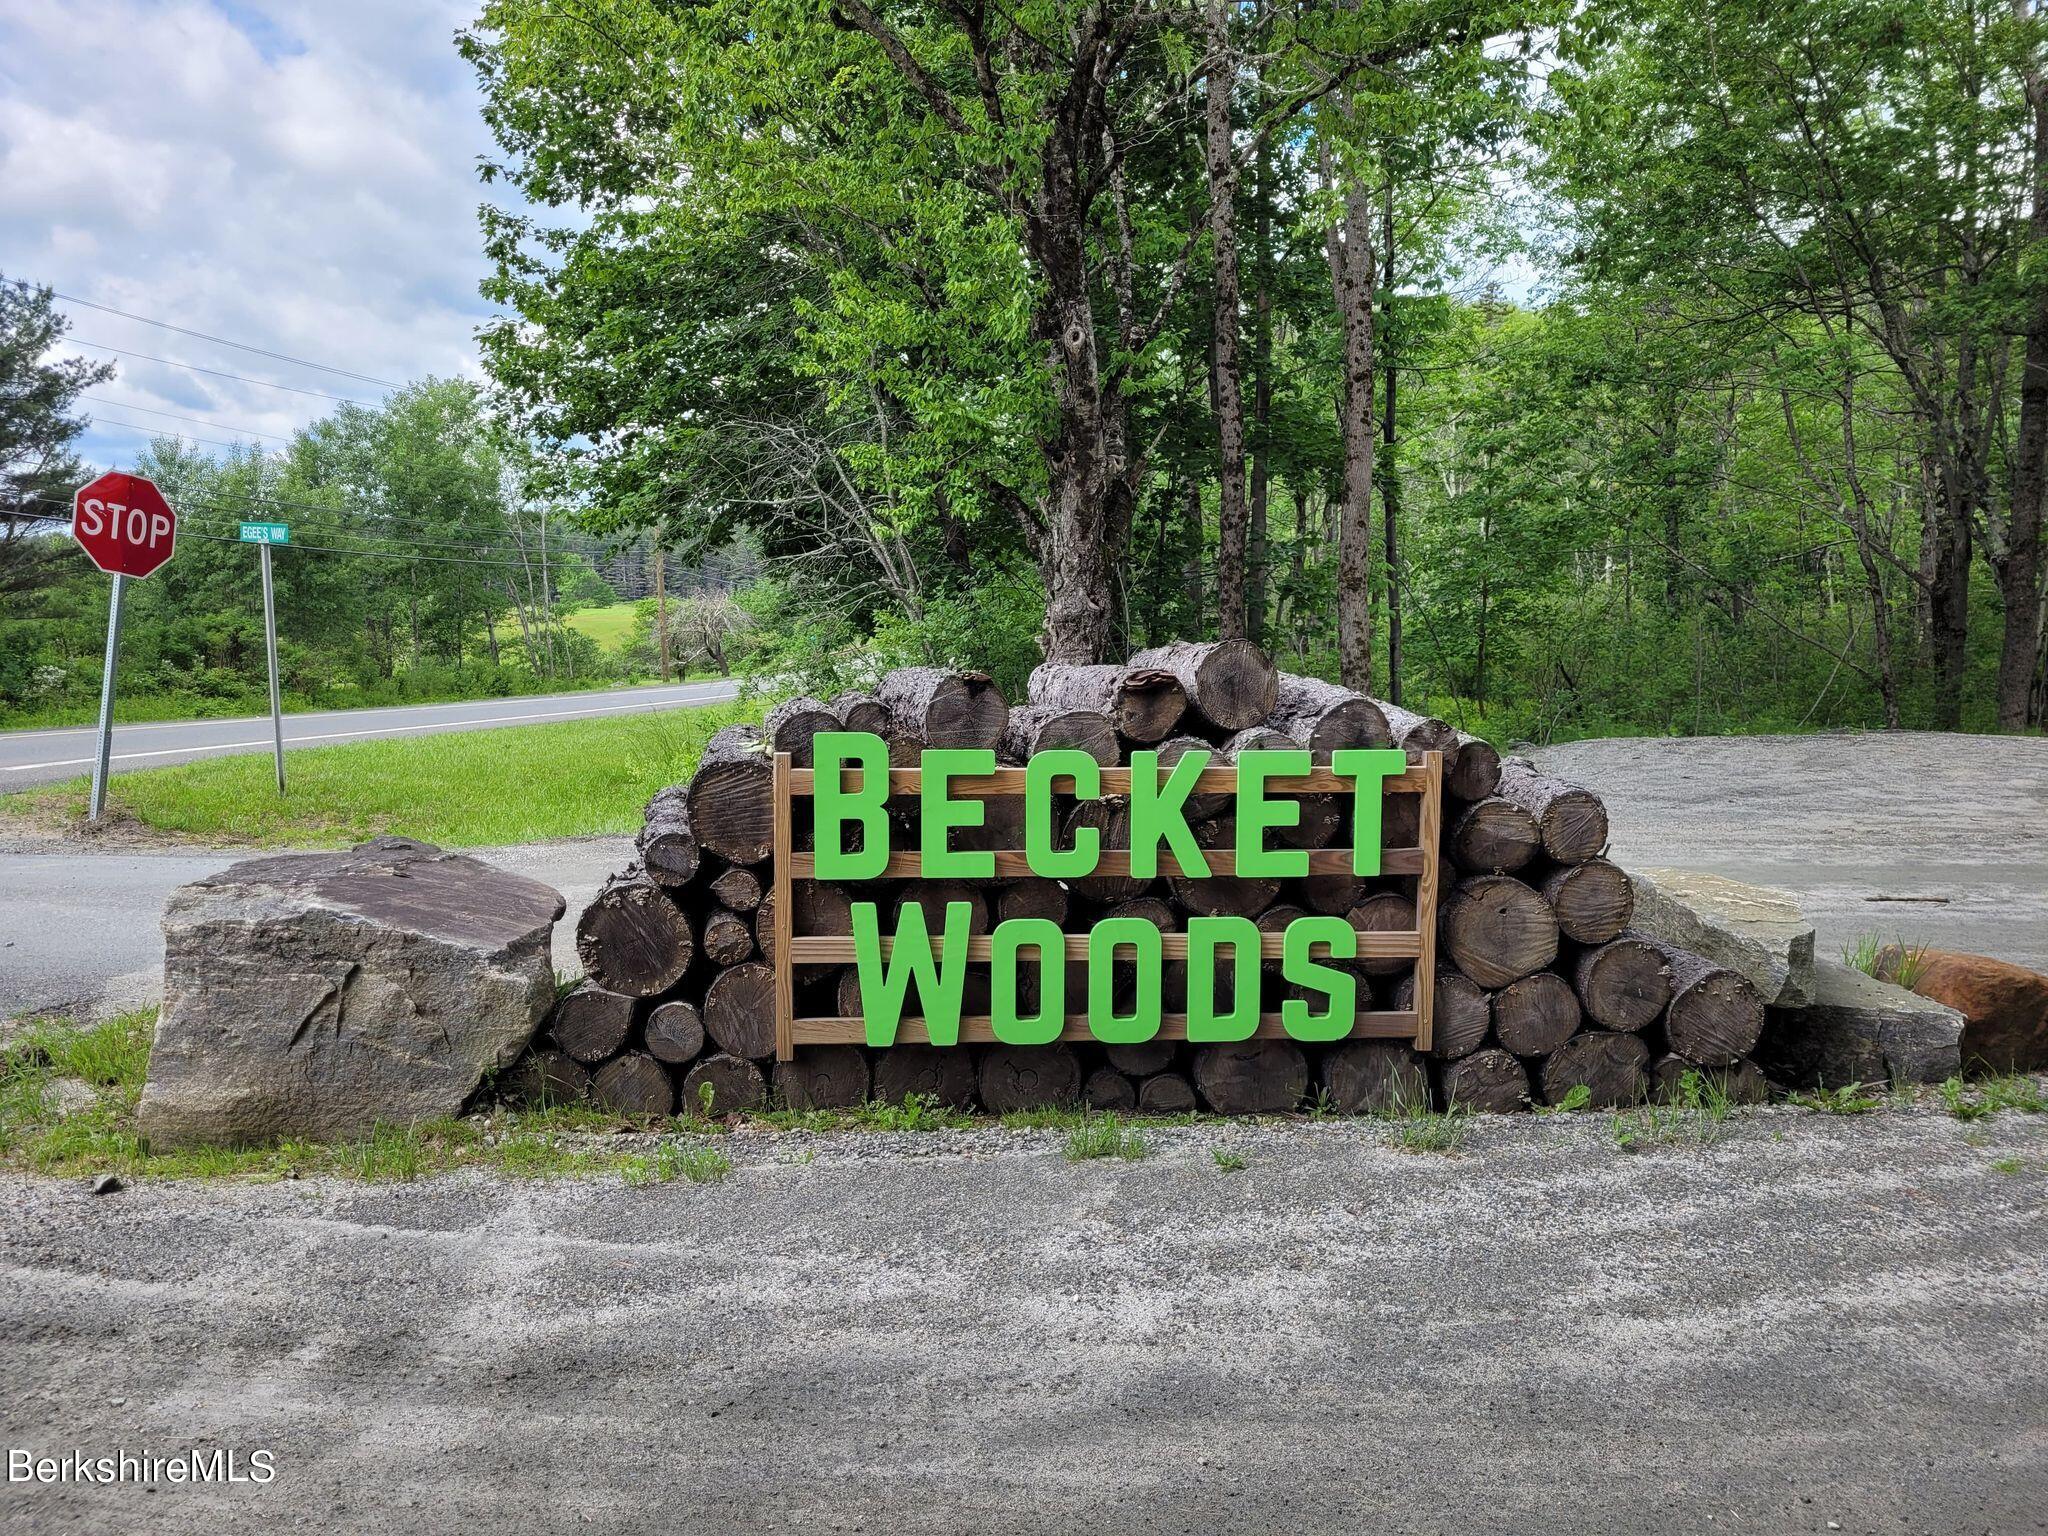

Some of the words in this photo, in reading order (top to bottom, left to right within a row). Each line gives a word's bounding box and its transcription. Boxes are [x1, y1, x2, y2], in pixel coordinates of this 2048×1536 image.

[81, 498, 171, 549] STOP
[242, 526, 268, 539] EGEE'S
[270, 527, 286, 540] WAY
[812, 731, 1407, 880] BECKET
[850, 901, 1358, 1047] WOODS
